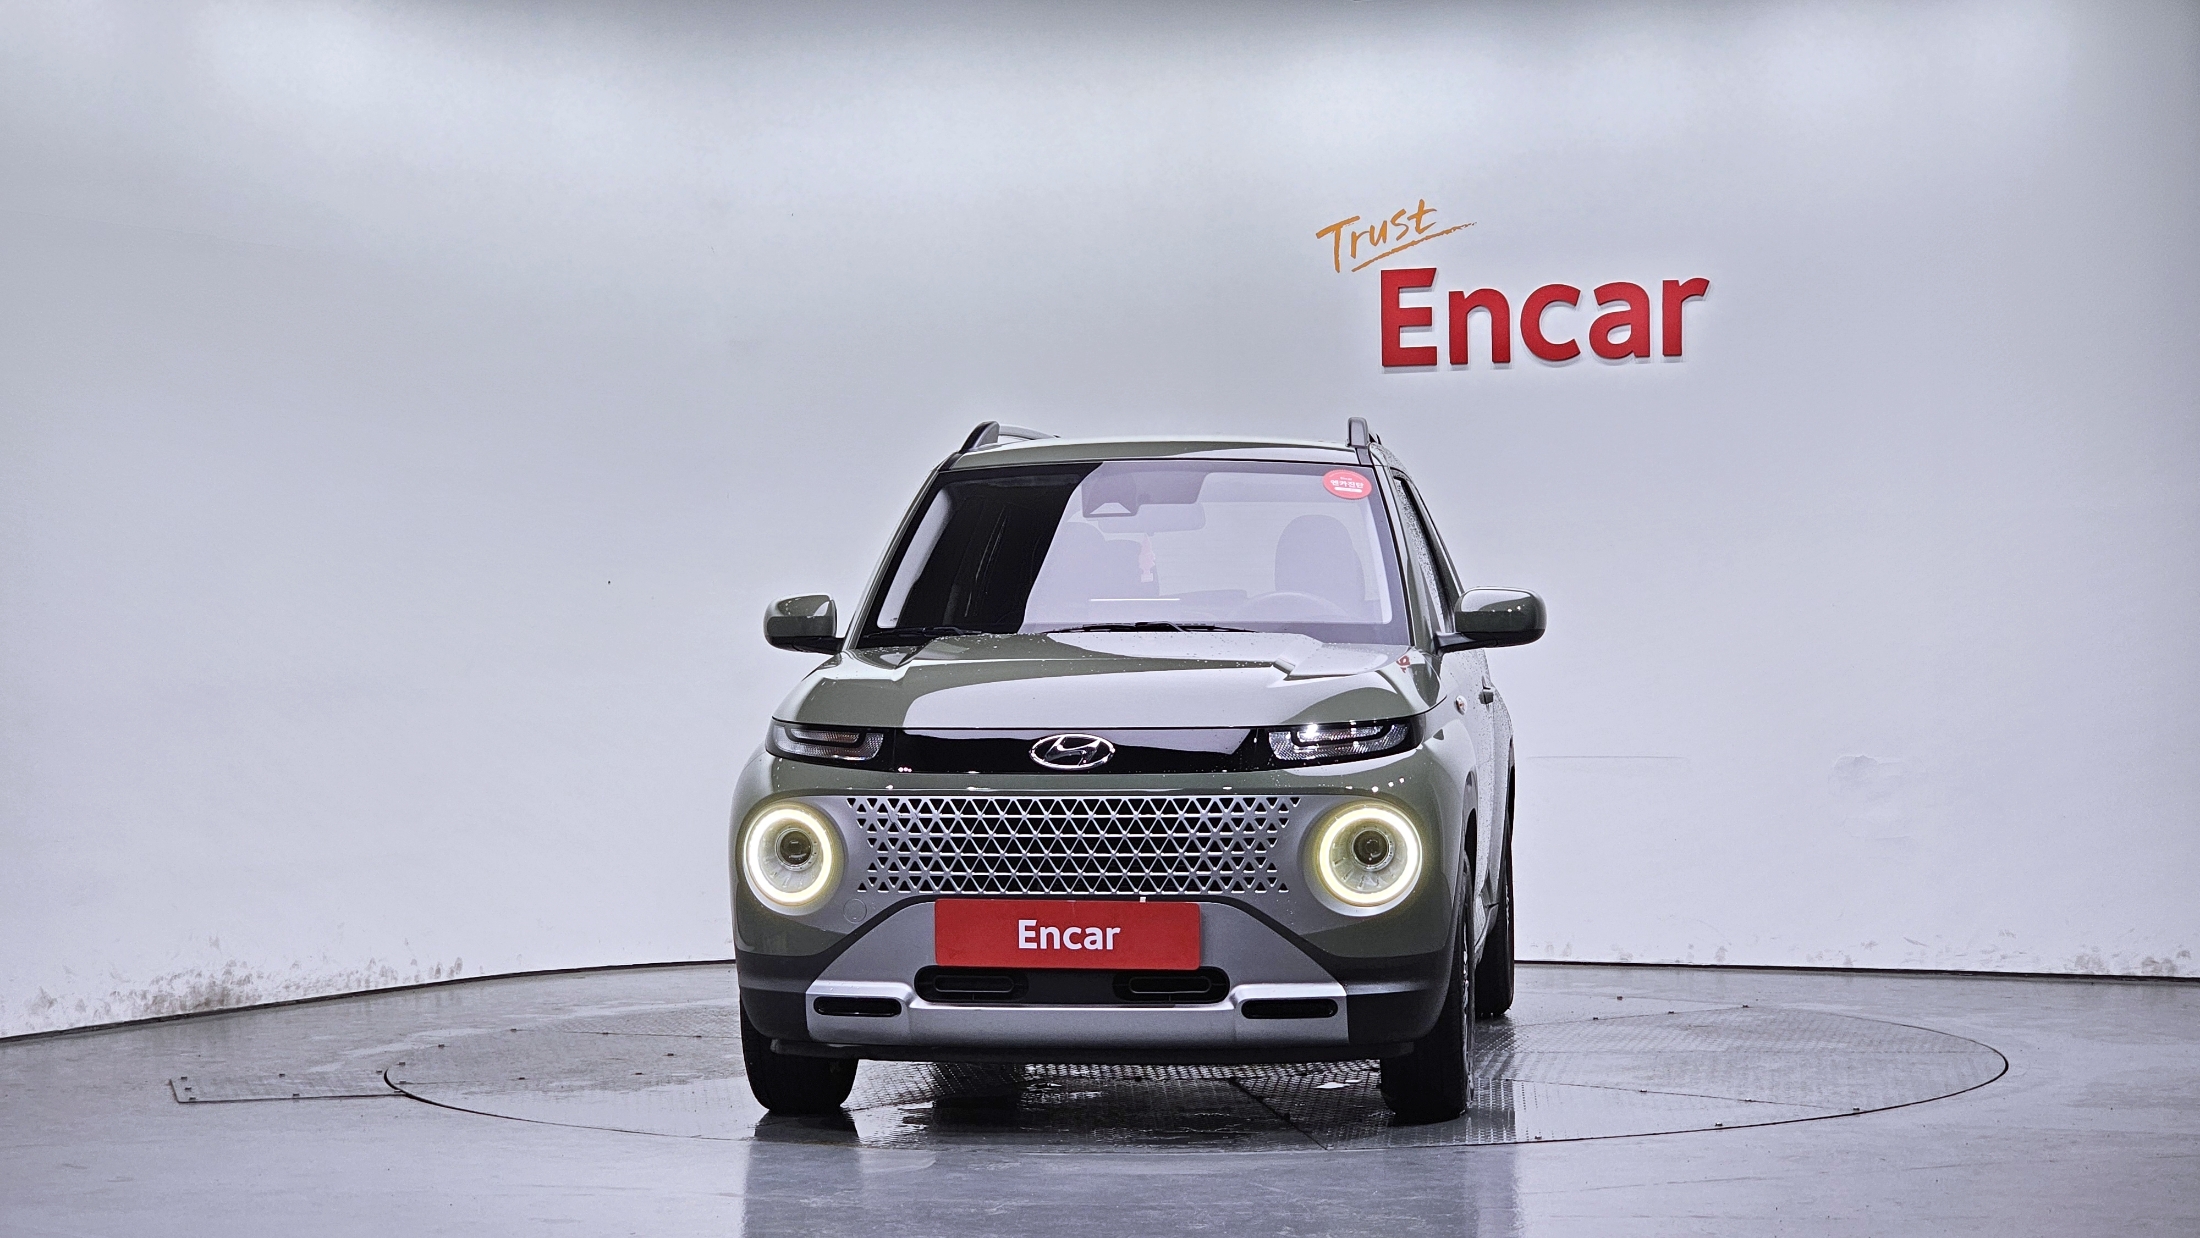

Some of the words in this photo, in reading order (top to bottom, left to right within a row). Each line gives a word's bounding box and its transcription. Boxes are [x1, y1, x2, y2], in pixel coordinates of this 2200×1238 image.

[1316, 199, 1438, 273] Trust
[1380, 267, 1711, 368] Encar
[1018, 919, 1121, 951] Encar
